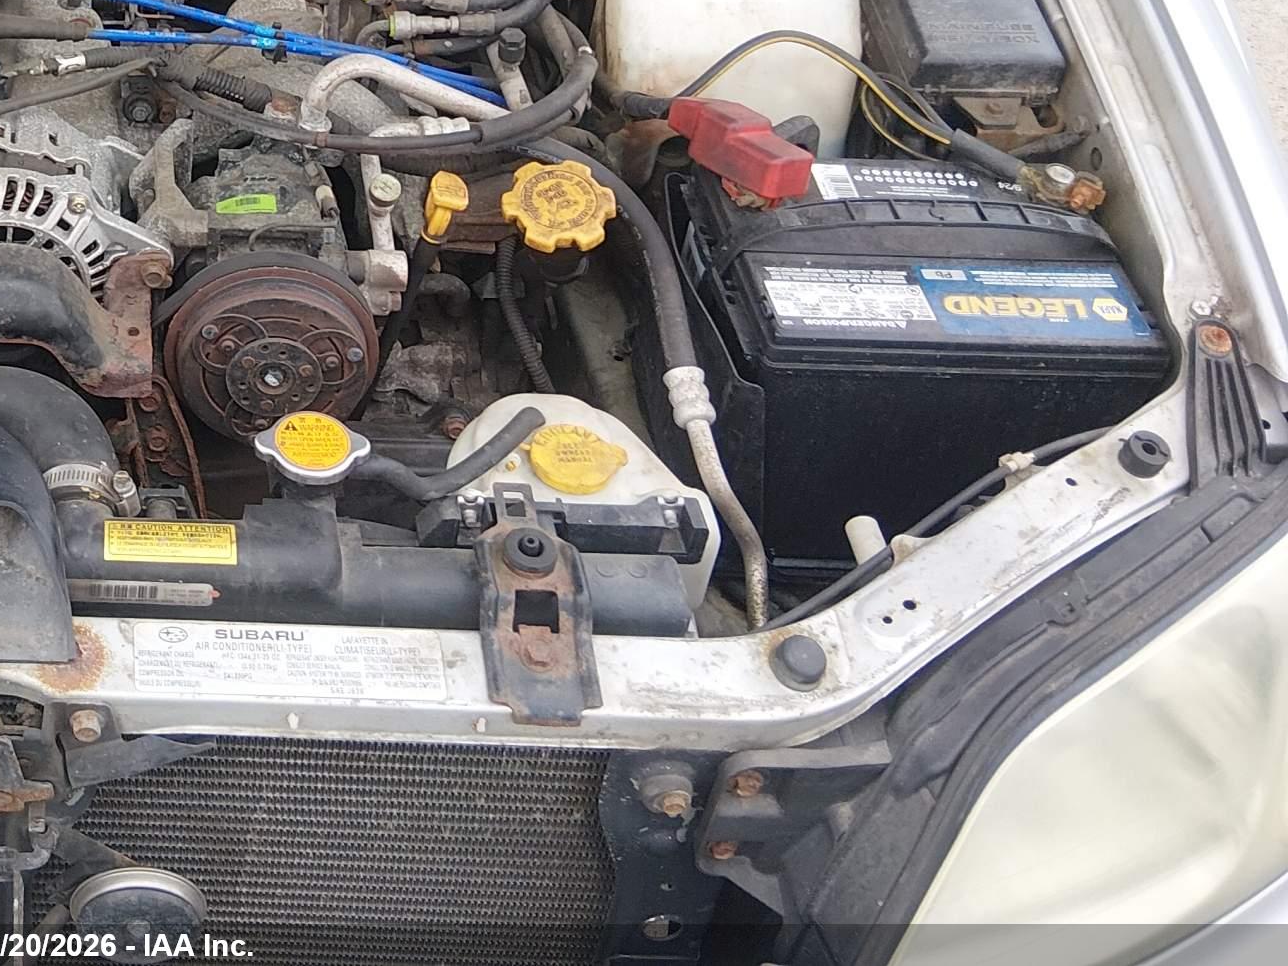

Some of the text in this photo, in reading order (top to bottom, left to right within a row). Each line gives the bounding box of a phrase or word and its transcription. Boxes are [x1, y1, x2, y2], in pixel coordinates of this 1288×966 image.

[943, 295, 1089, 319] LEGEND
[135, 523, 172, 532] CAUTION
[177, 524, 229, 534] ATTENTION
[215, 628, 304, 642] SUBARU
[194, 641, 210, 651] AIR
